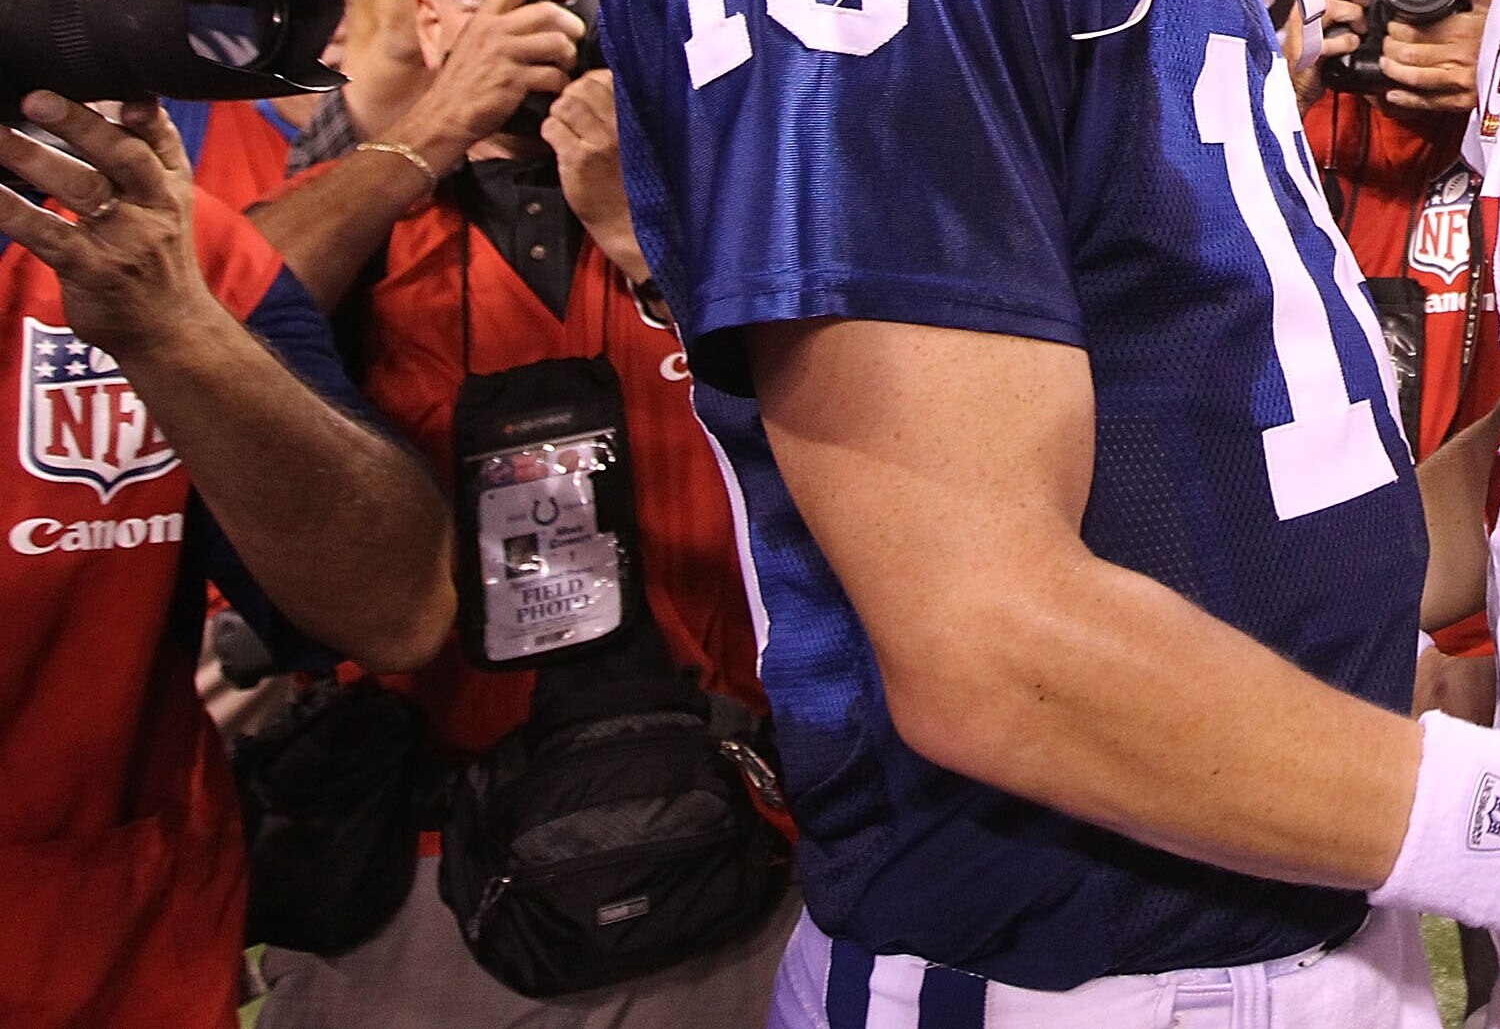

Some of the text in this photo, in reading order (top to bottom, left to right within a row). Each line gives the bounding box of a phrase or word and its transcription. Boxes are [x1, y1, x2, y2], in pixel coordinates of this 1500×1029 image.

[1418, 208, 1470, 261] NF
[1462, 263, 1481, 365] DIGITAL
[11, 512, 184, 556] Canon
[516, 594, 590, 623] PHOTO
[522, 579, 583, 605] FIELD
